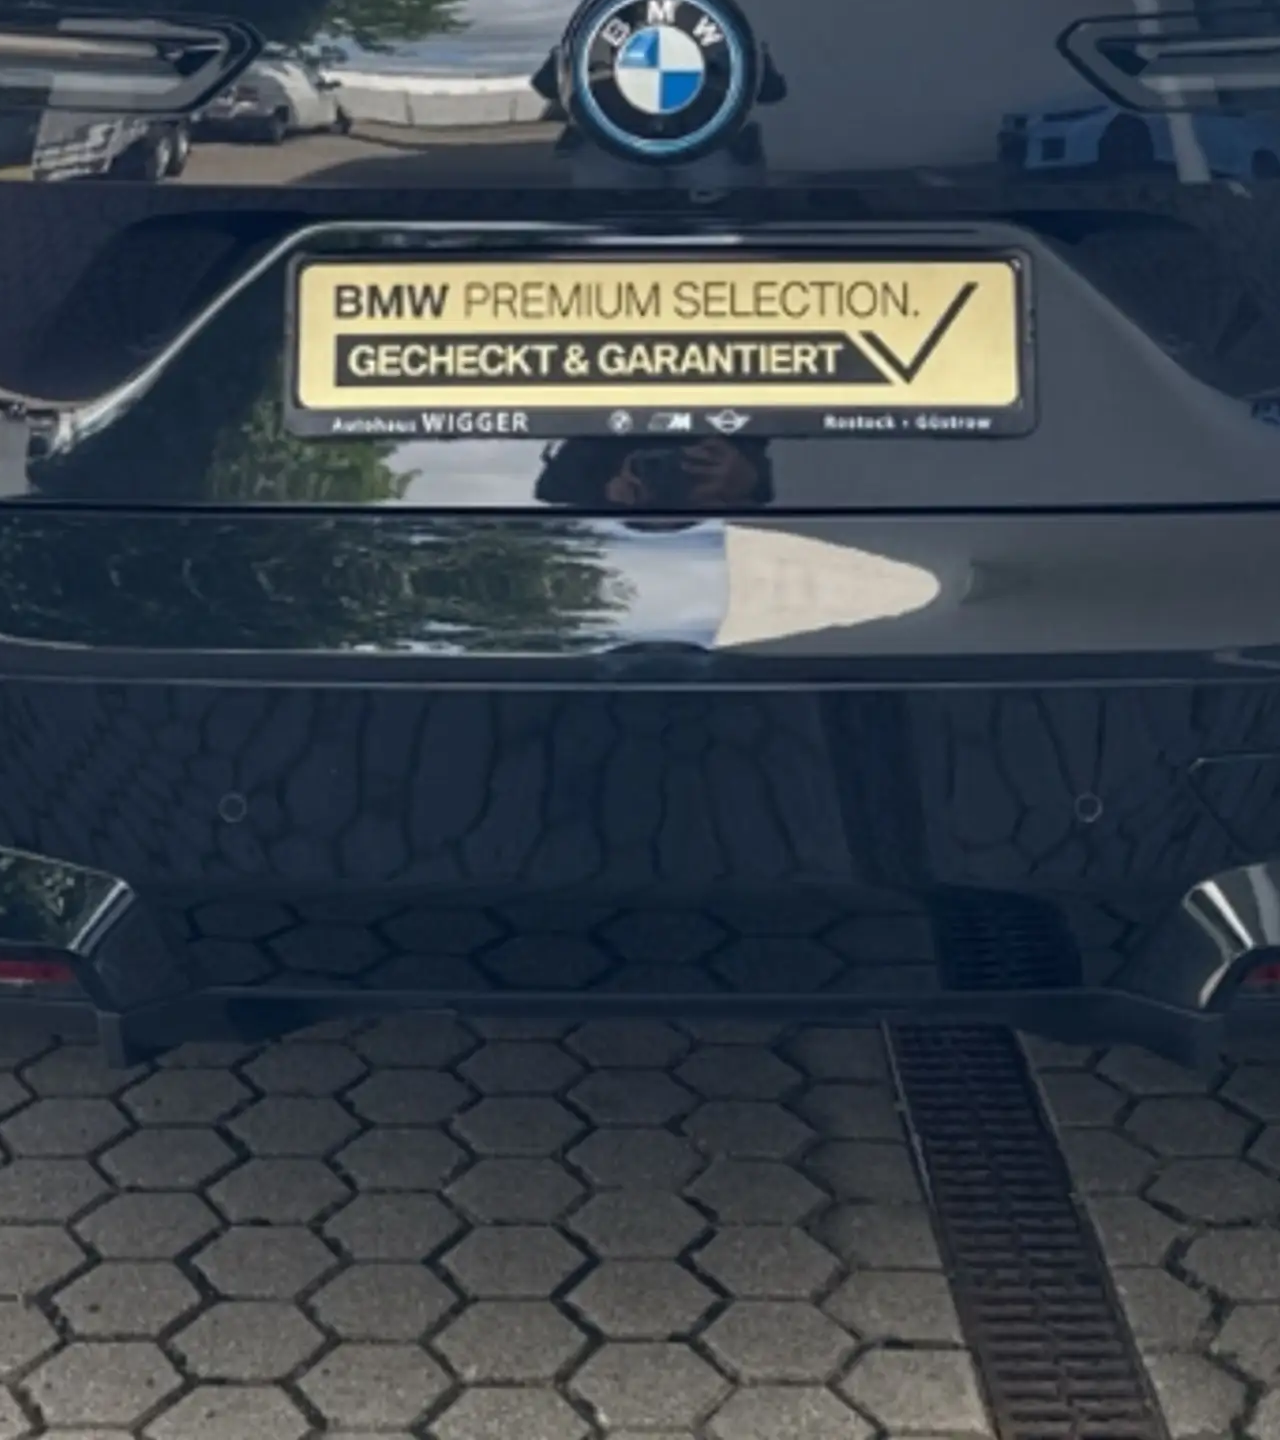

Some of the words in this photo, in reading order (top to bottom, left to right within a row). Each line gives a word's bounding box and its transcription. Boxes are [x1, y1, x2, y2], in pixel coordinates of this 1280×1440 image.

[334, 284, 449, 319] BMW
[464, 282, 661, 319] PREMIUM
[673, 281, 920, 318] SELECTION.
[347, 344, 557, 377] GECHECKT
[563, 344, 589, 376] &
[596, 342, 844, 376] GARANTIERT
[332, 416, 417, 433] Autohaus
[421, 411, 530, 434] WIGGER
[822, 414, 896, 430] Rostock
[914, 413, 993, 431] Güstrow
